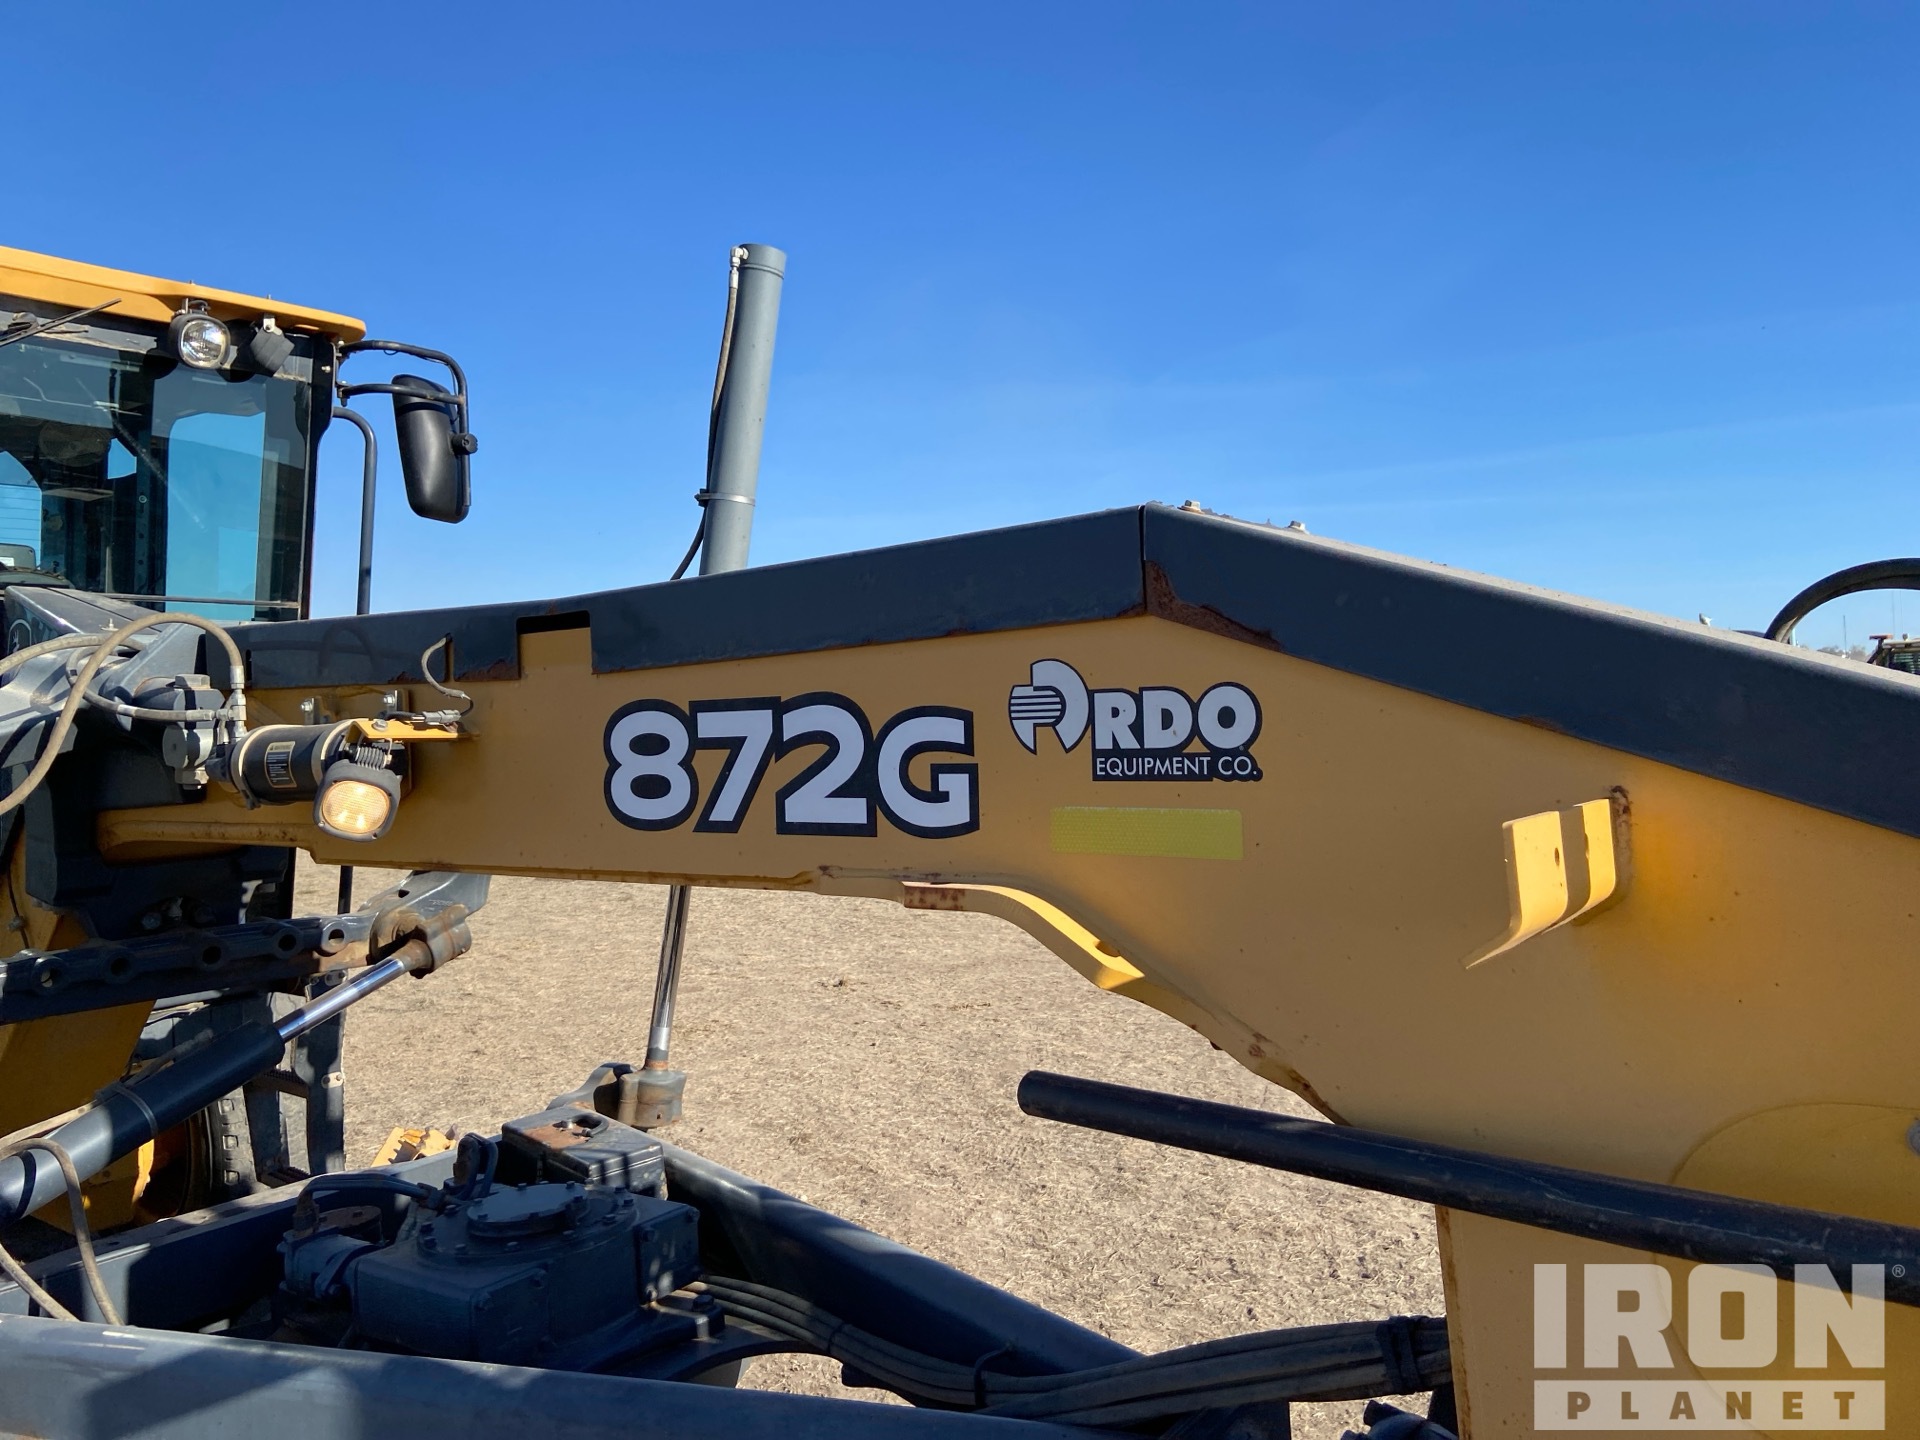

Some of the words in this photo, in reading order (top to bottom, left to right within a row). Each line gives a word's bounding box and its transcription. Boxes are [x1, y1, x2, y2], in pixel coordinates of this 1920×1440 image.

[606, 698, 977, 833] 872G
[1096, 757, 1211, 776] EQUIPMENT
[1217, 755, 1258, 776] CO.
